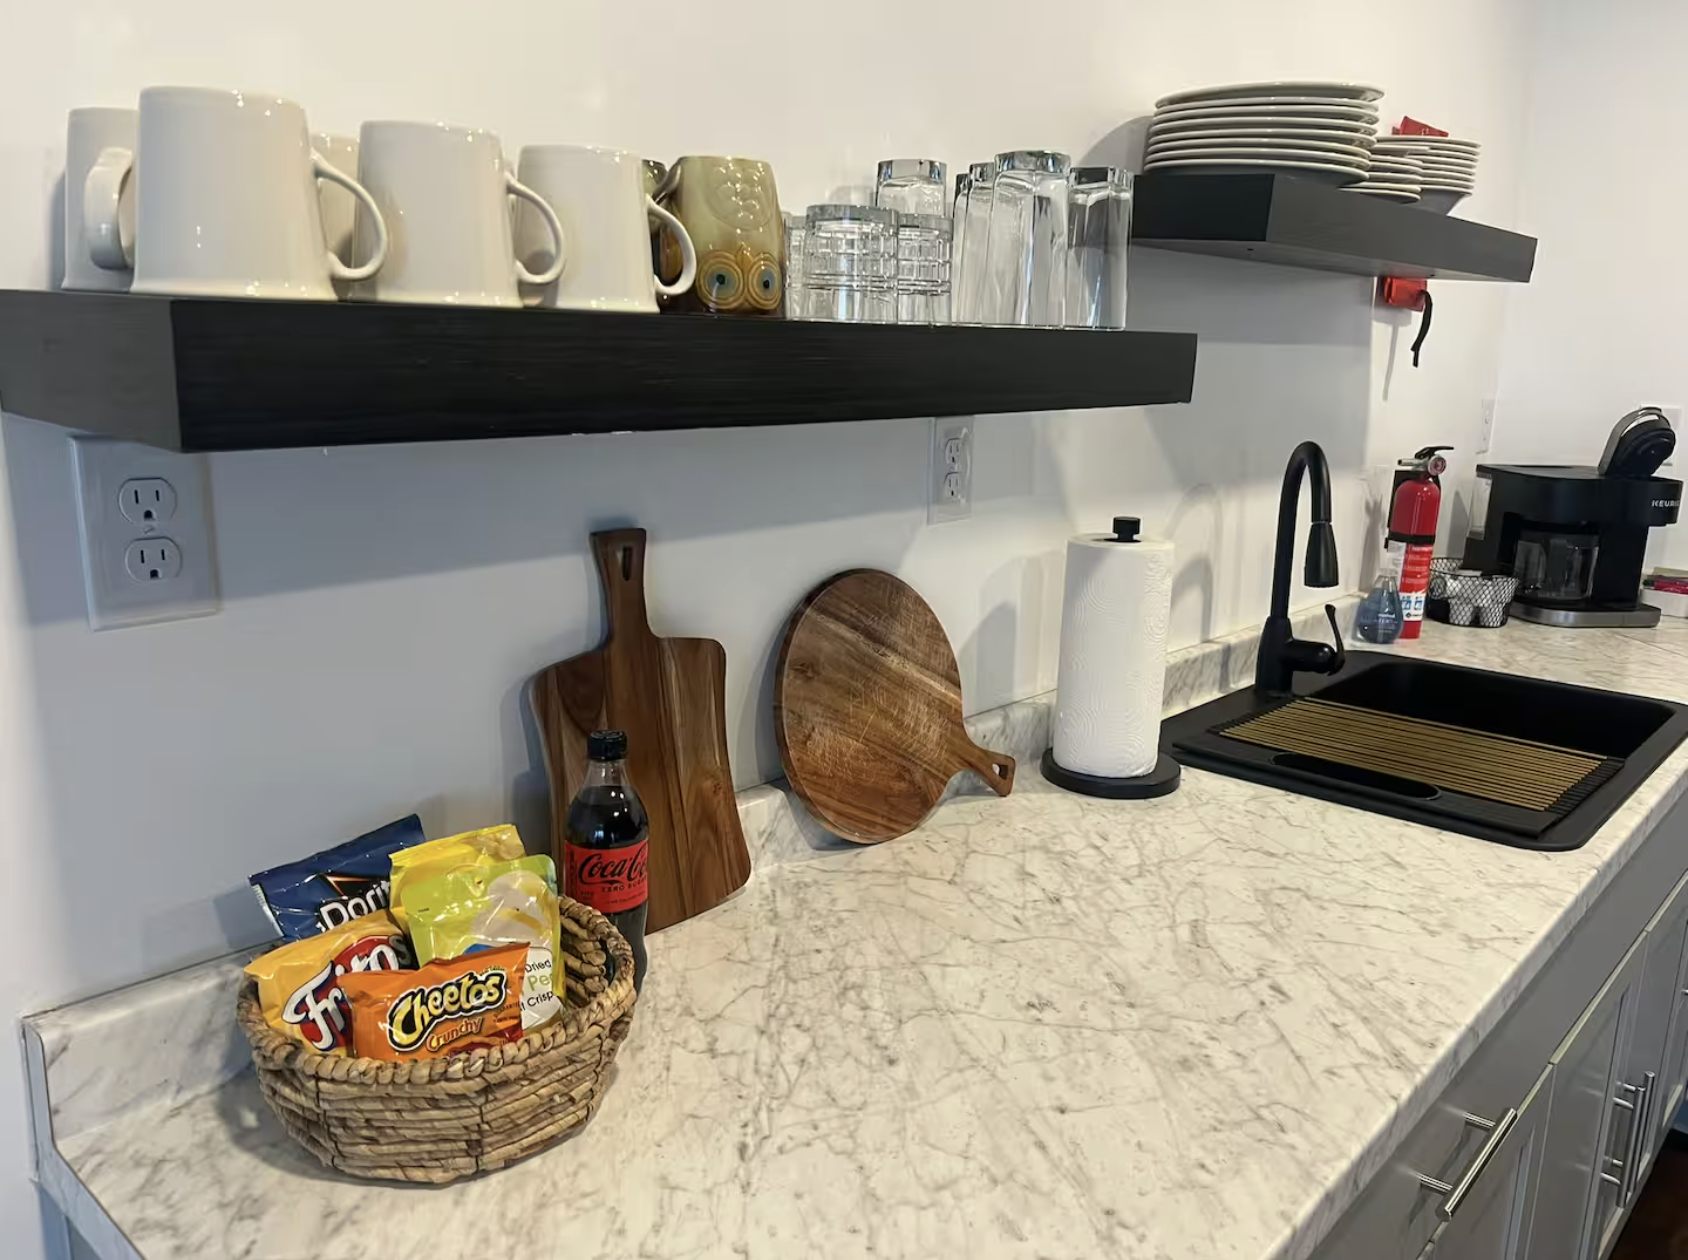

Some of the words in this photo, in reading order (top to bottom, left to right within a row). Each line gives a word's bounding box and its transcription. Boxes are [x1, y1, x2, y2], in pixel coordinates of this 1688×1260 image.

[600, 885, 626, 893] ZERO
[628, 877, 647, 890] SUGA
[525, 959, 552, 973] Dried
[282, 935, 414, 1050] Fros
[527, 974, 553, 991] Pe
[390, 971, 503, 1048] Cheetos
[426, 1017, 485, 1051] Crunchy
